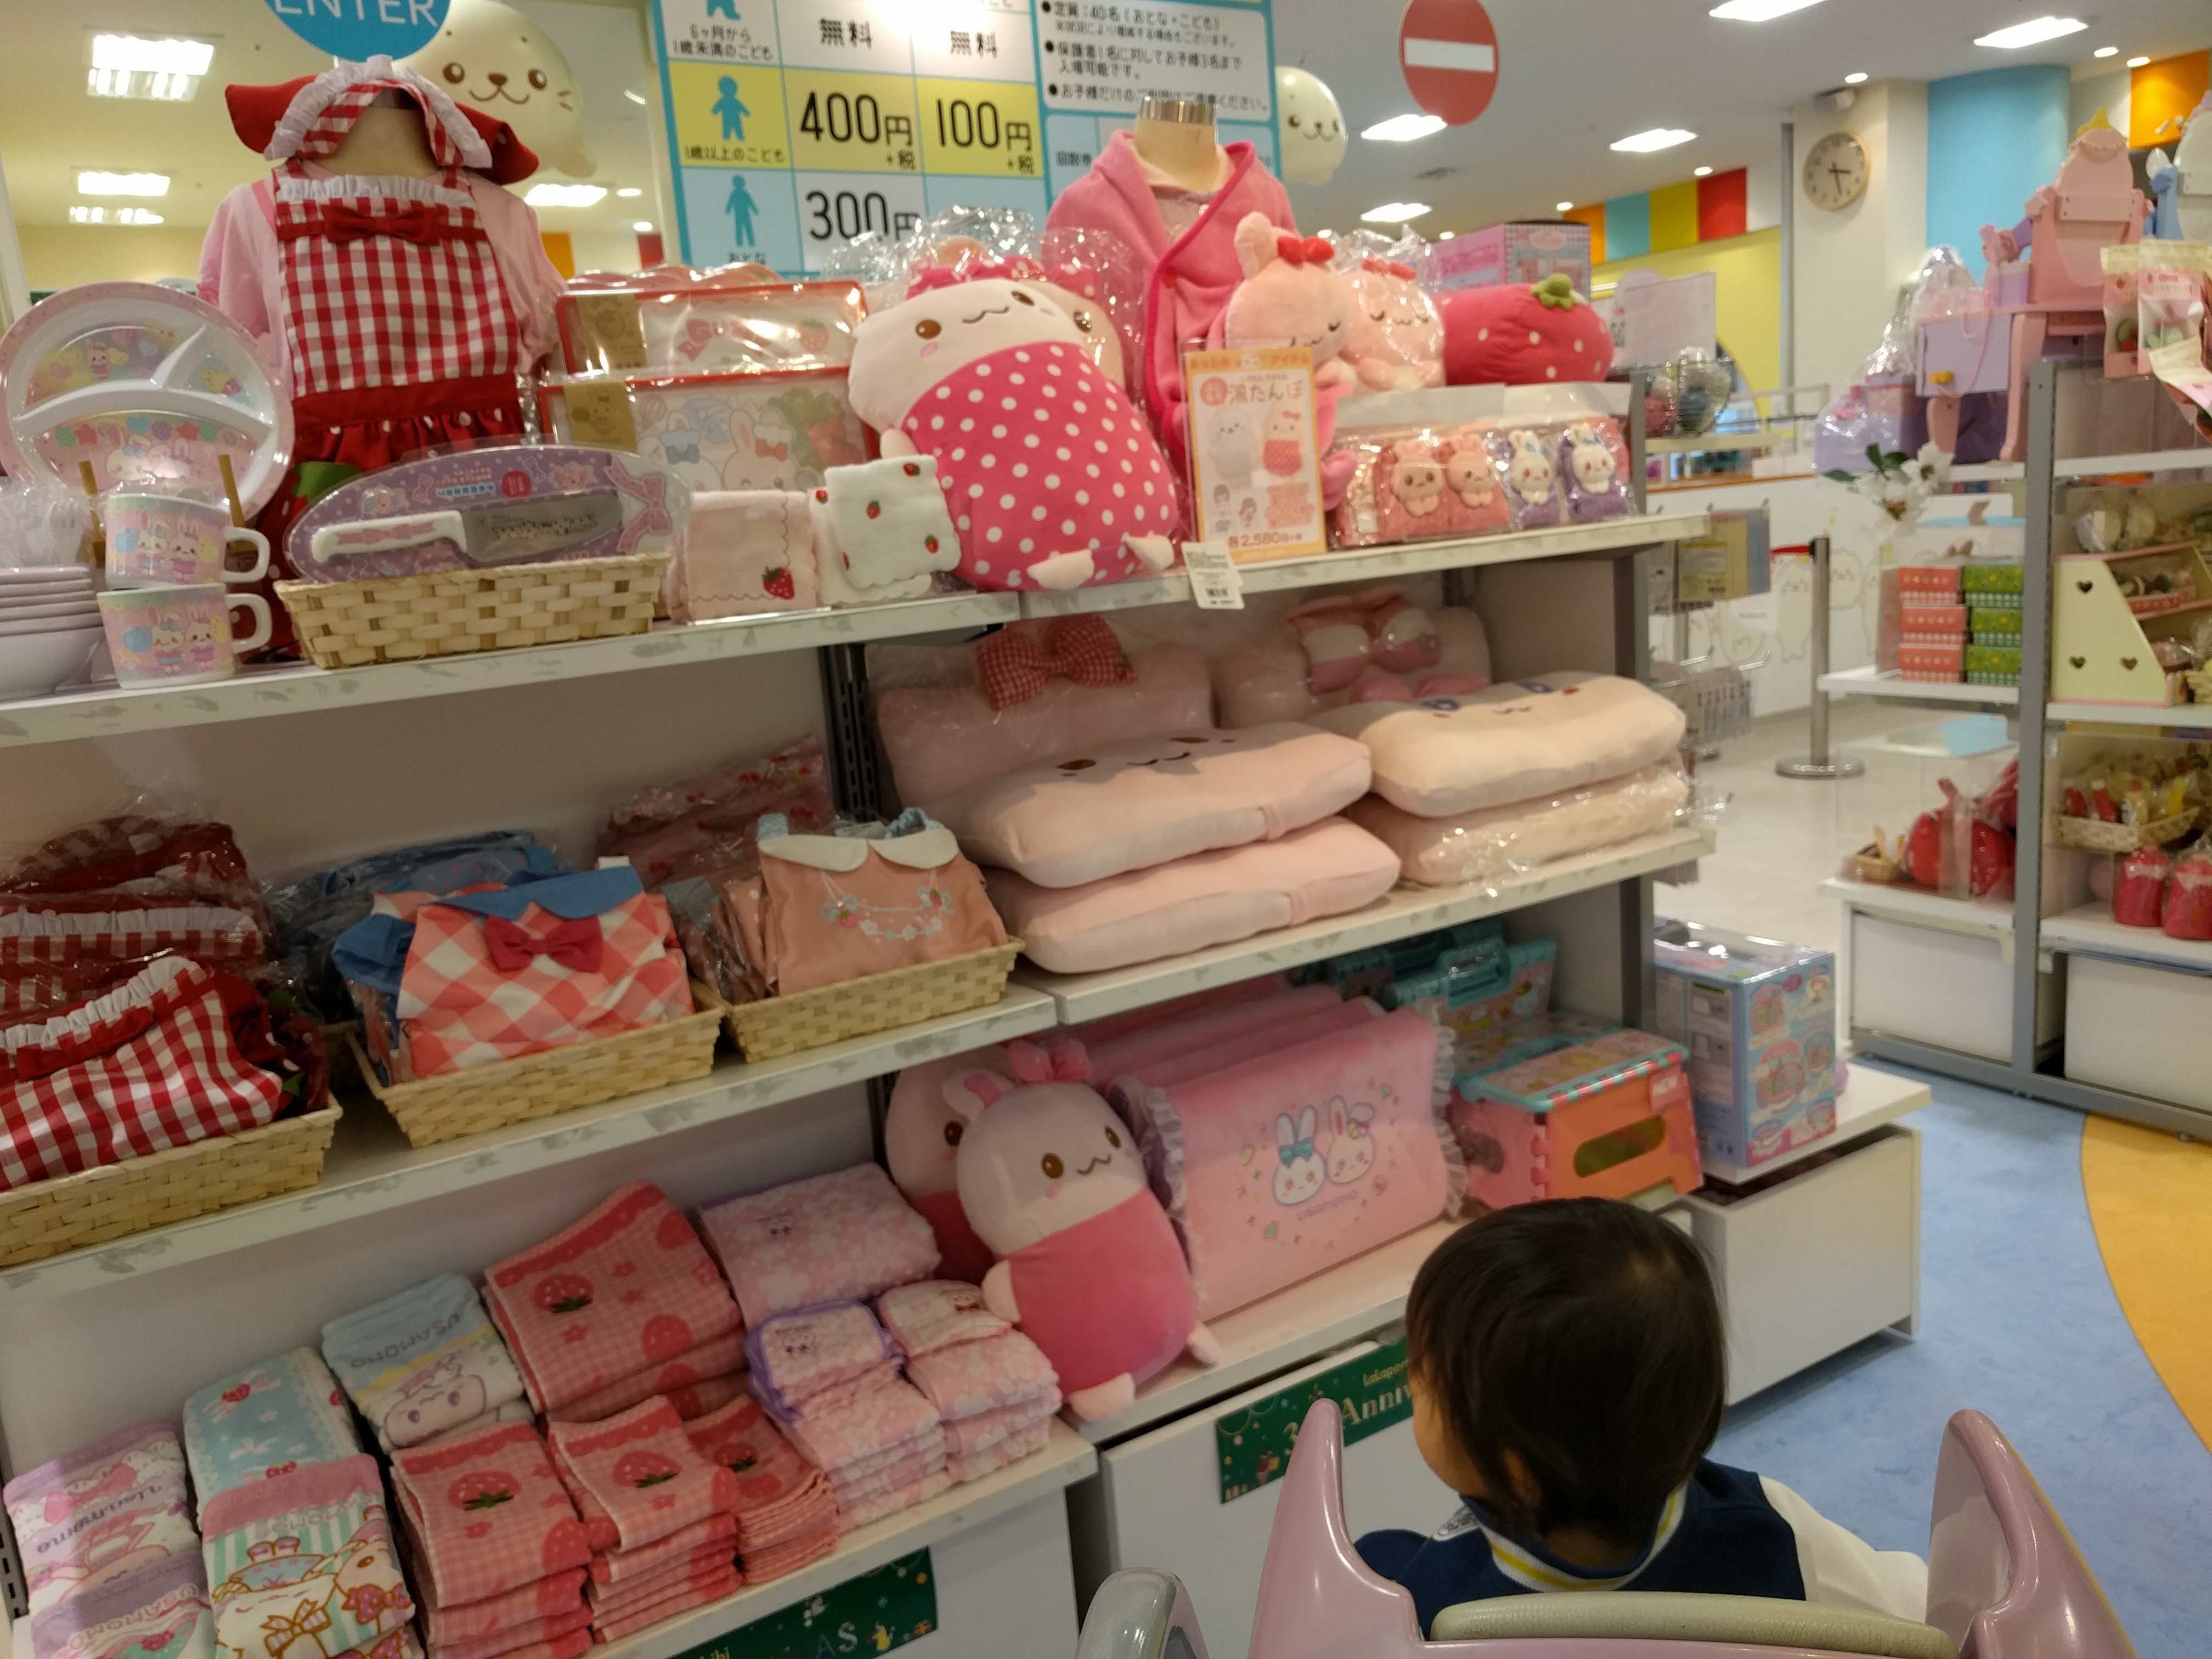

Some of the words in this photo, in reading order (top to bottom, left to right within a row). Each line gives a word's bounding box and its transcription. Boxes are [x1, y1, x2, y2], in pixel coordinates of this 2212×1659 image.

[819, 18, 874, 49] 無料
[949, 31, 998, 59] 無料
[800, 91, 913, 146] 400円
[936, 98, 1032, 153] 100円
[351, 1313, 462, 1368] USAMOMO
